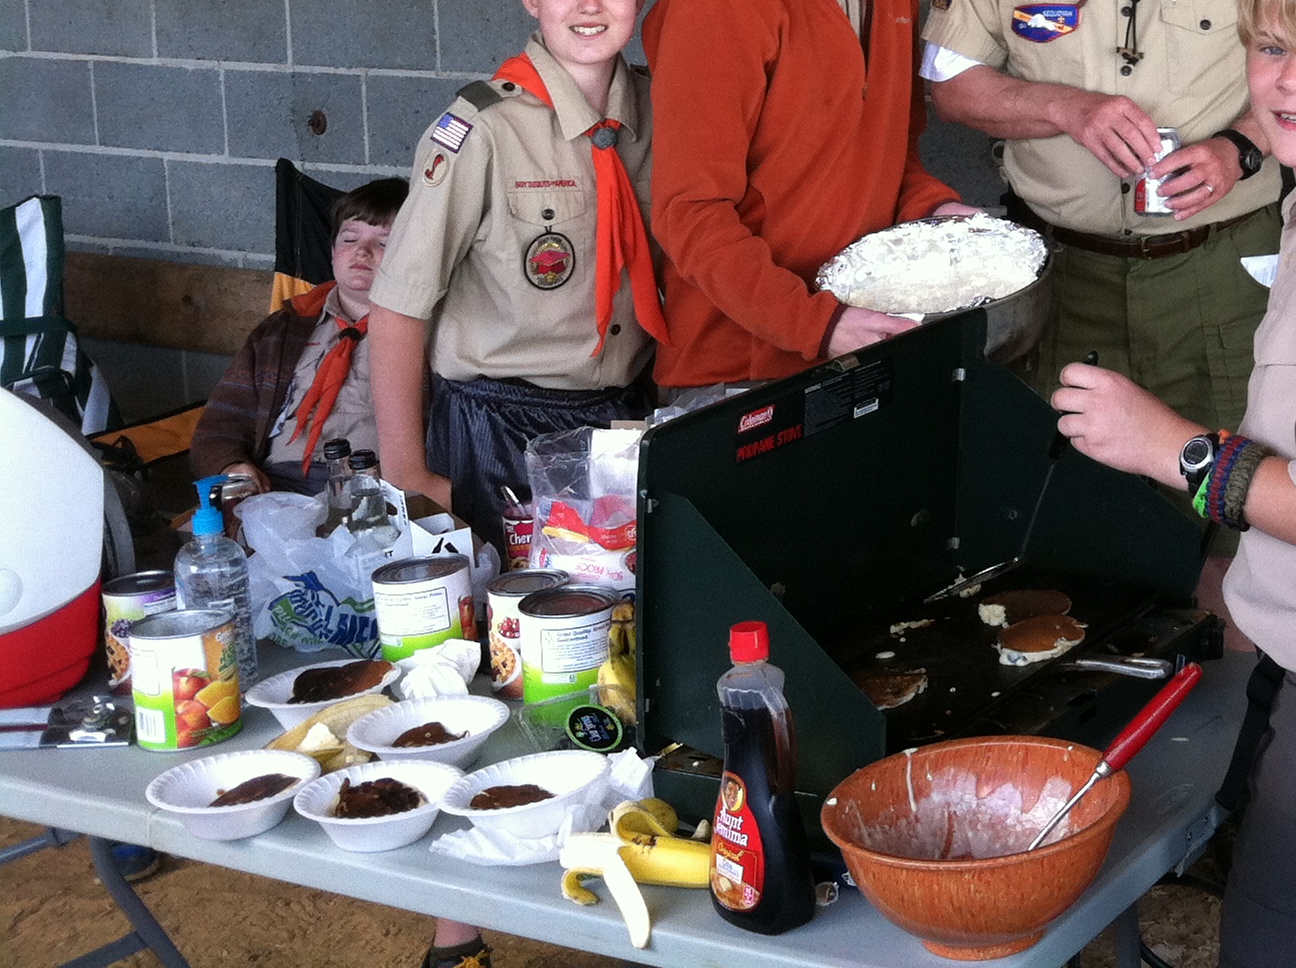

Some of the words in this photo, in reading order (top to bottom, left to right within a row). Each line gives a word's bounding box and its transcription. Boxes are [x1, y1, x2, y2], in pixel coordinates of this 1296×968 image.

[736, 435, 775, 462] PROPANE
[777, 424, 804, 446] STOVE
[720, 807, 744, 831] Aunt
